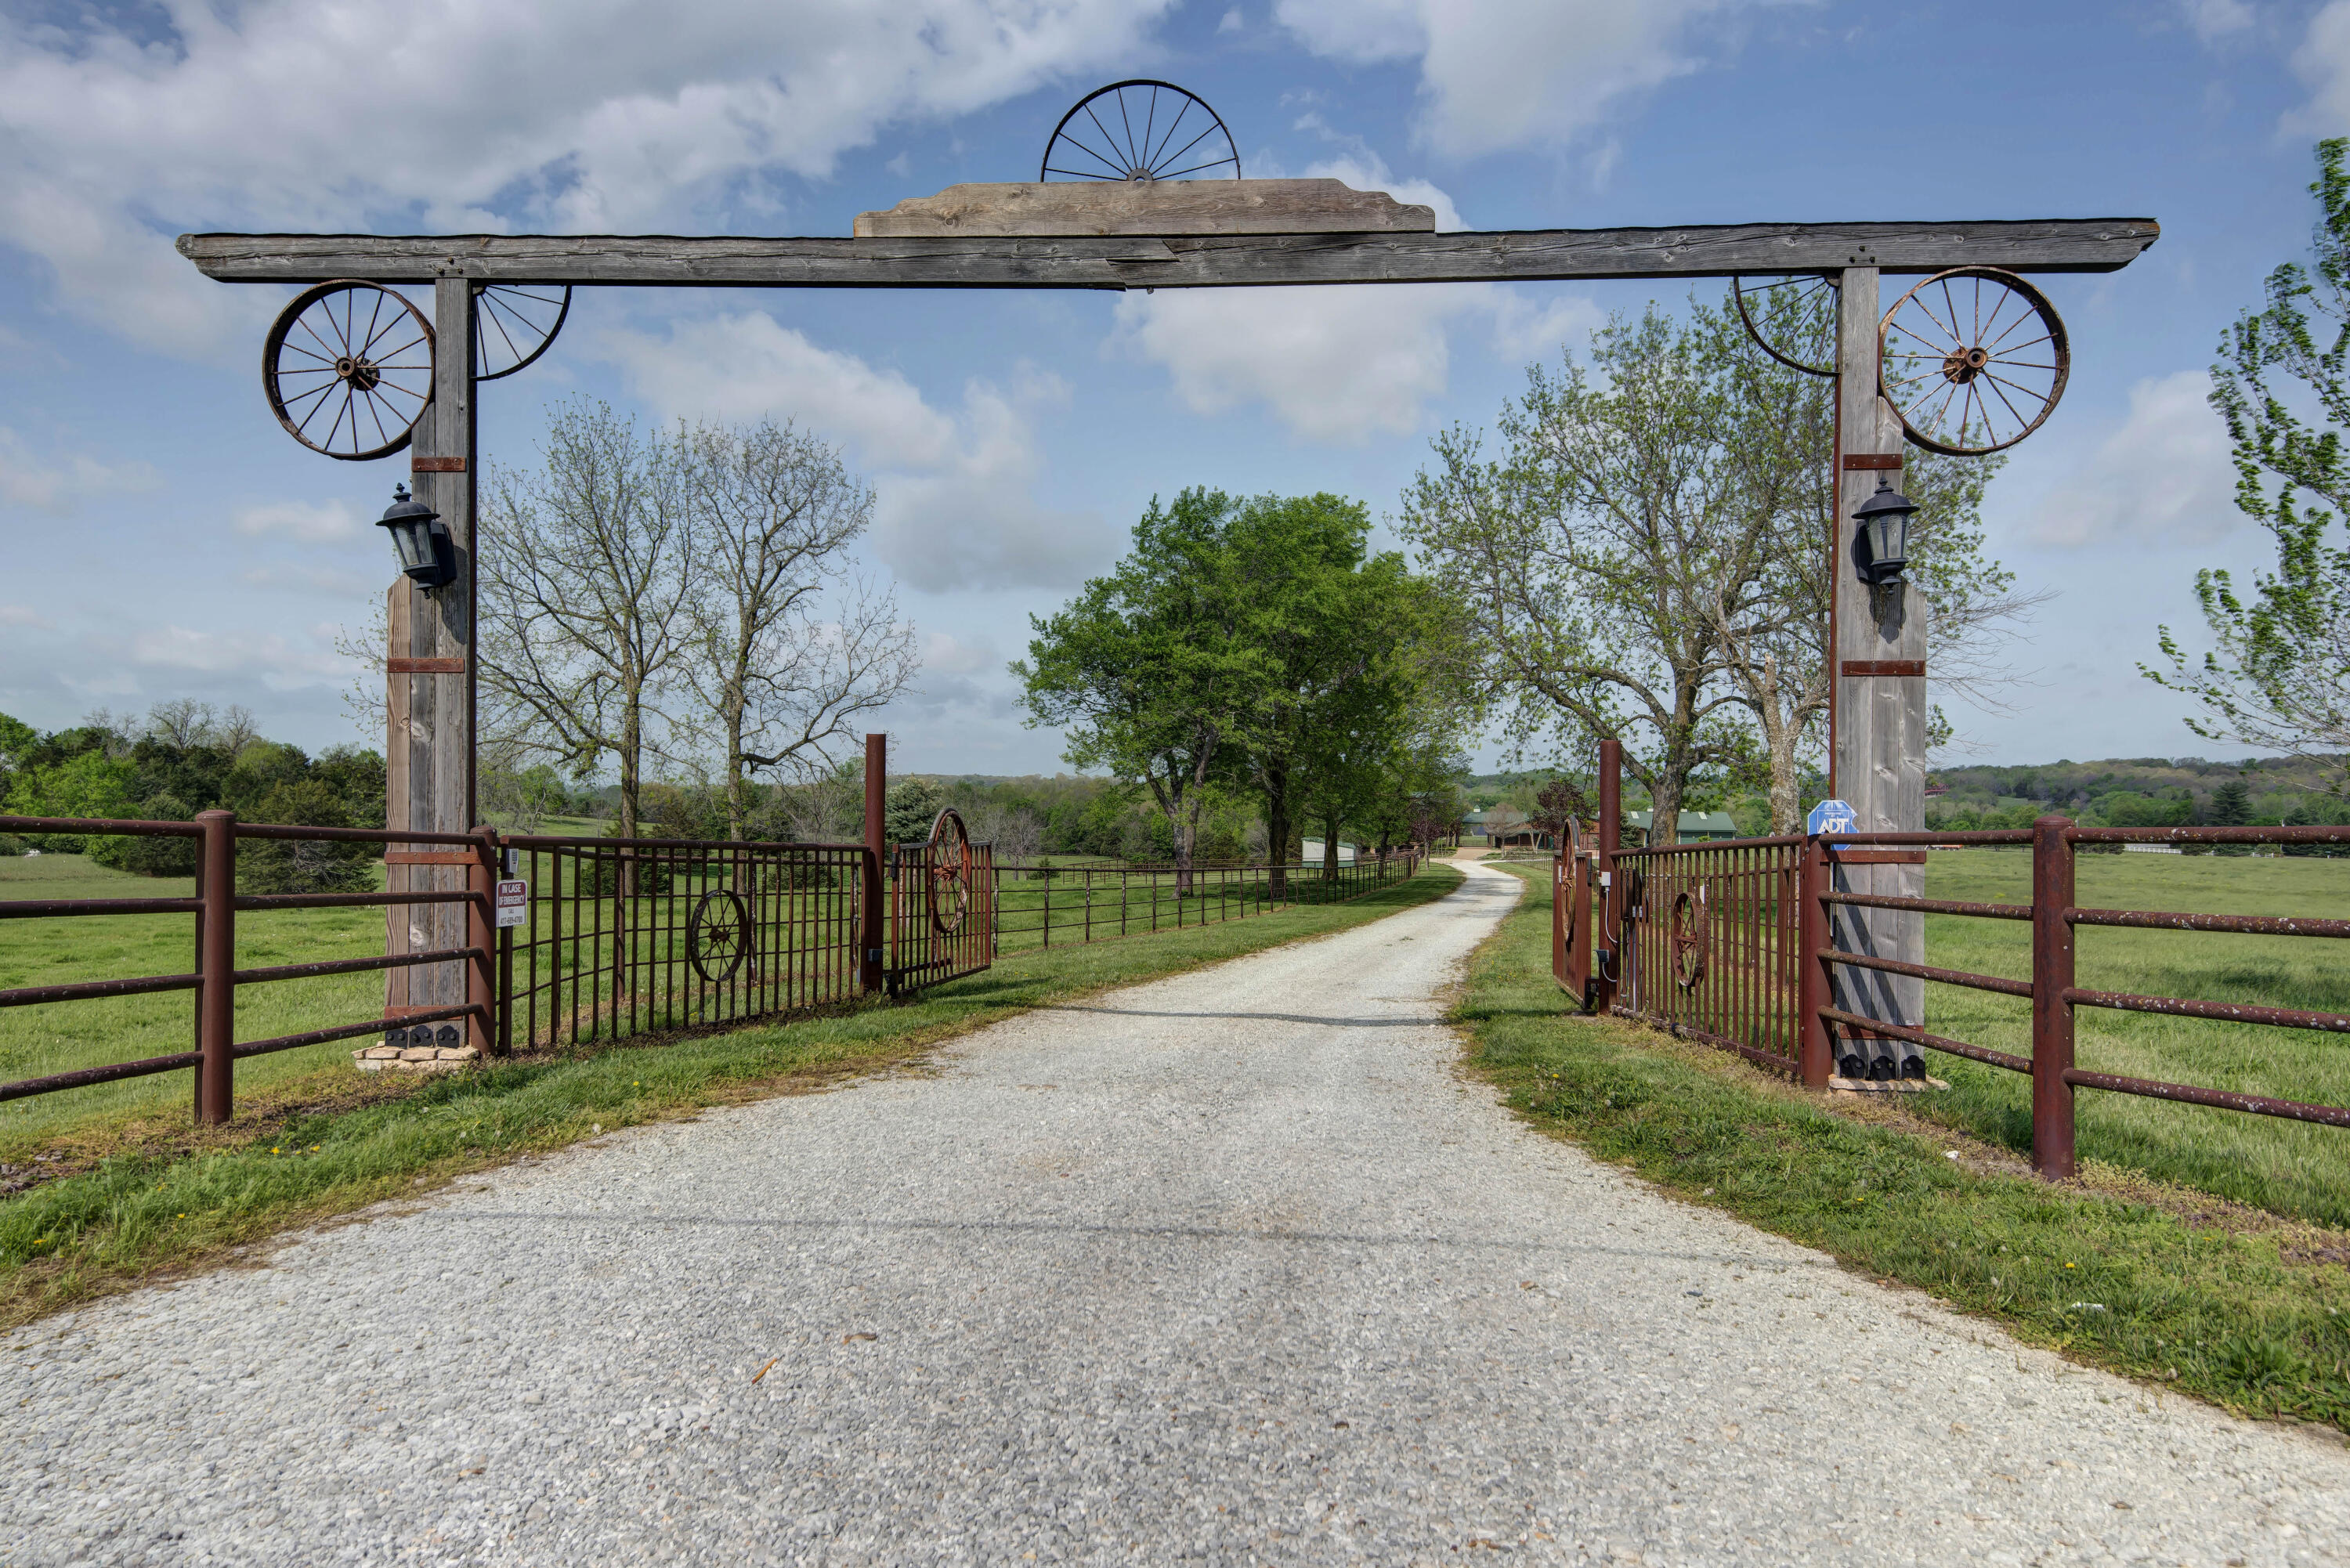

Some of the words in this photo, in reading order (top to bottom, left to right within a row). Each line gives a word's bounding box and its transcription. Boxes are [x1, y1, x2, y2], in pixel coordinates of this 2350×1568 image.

[1818, 818, 1849, 834] ADT
[501, 884, 508, 894] IN
[508, 883, 522, 893] CASE
[504, 894, 525, 905] EMERGENCY
